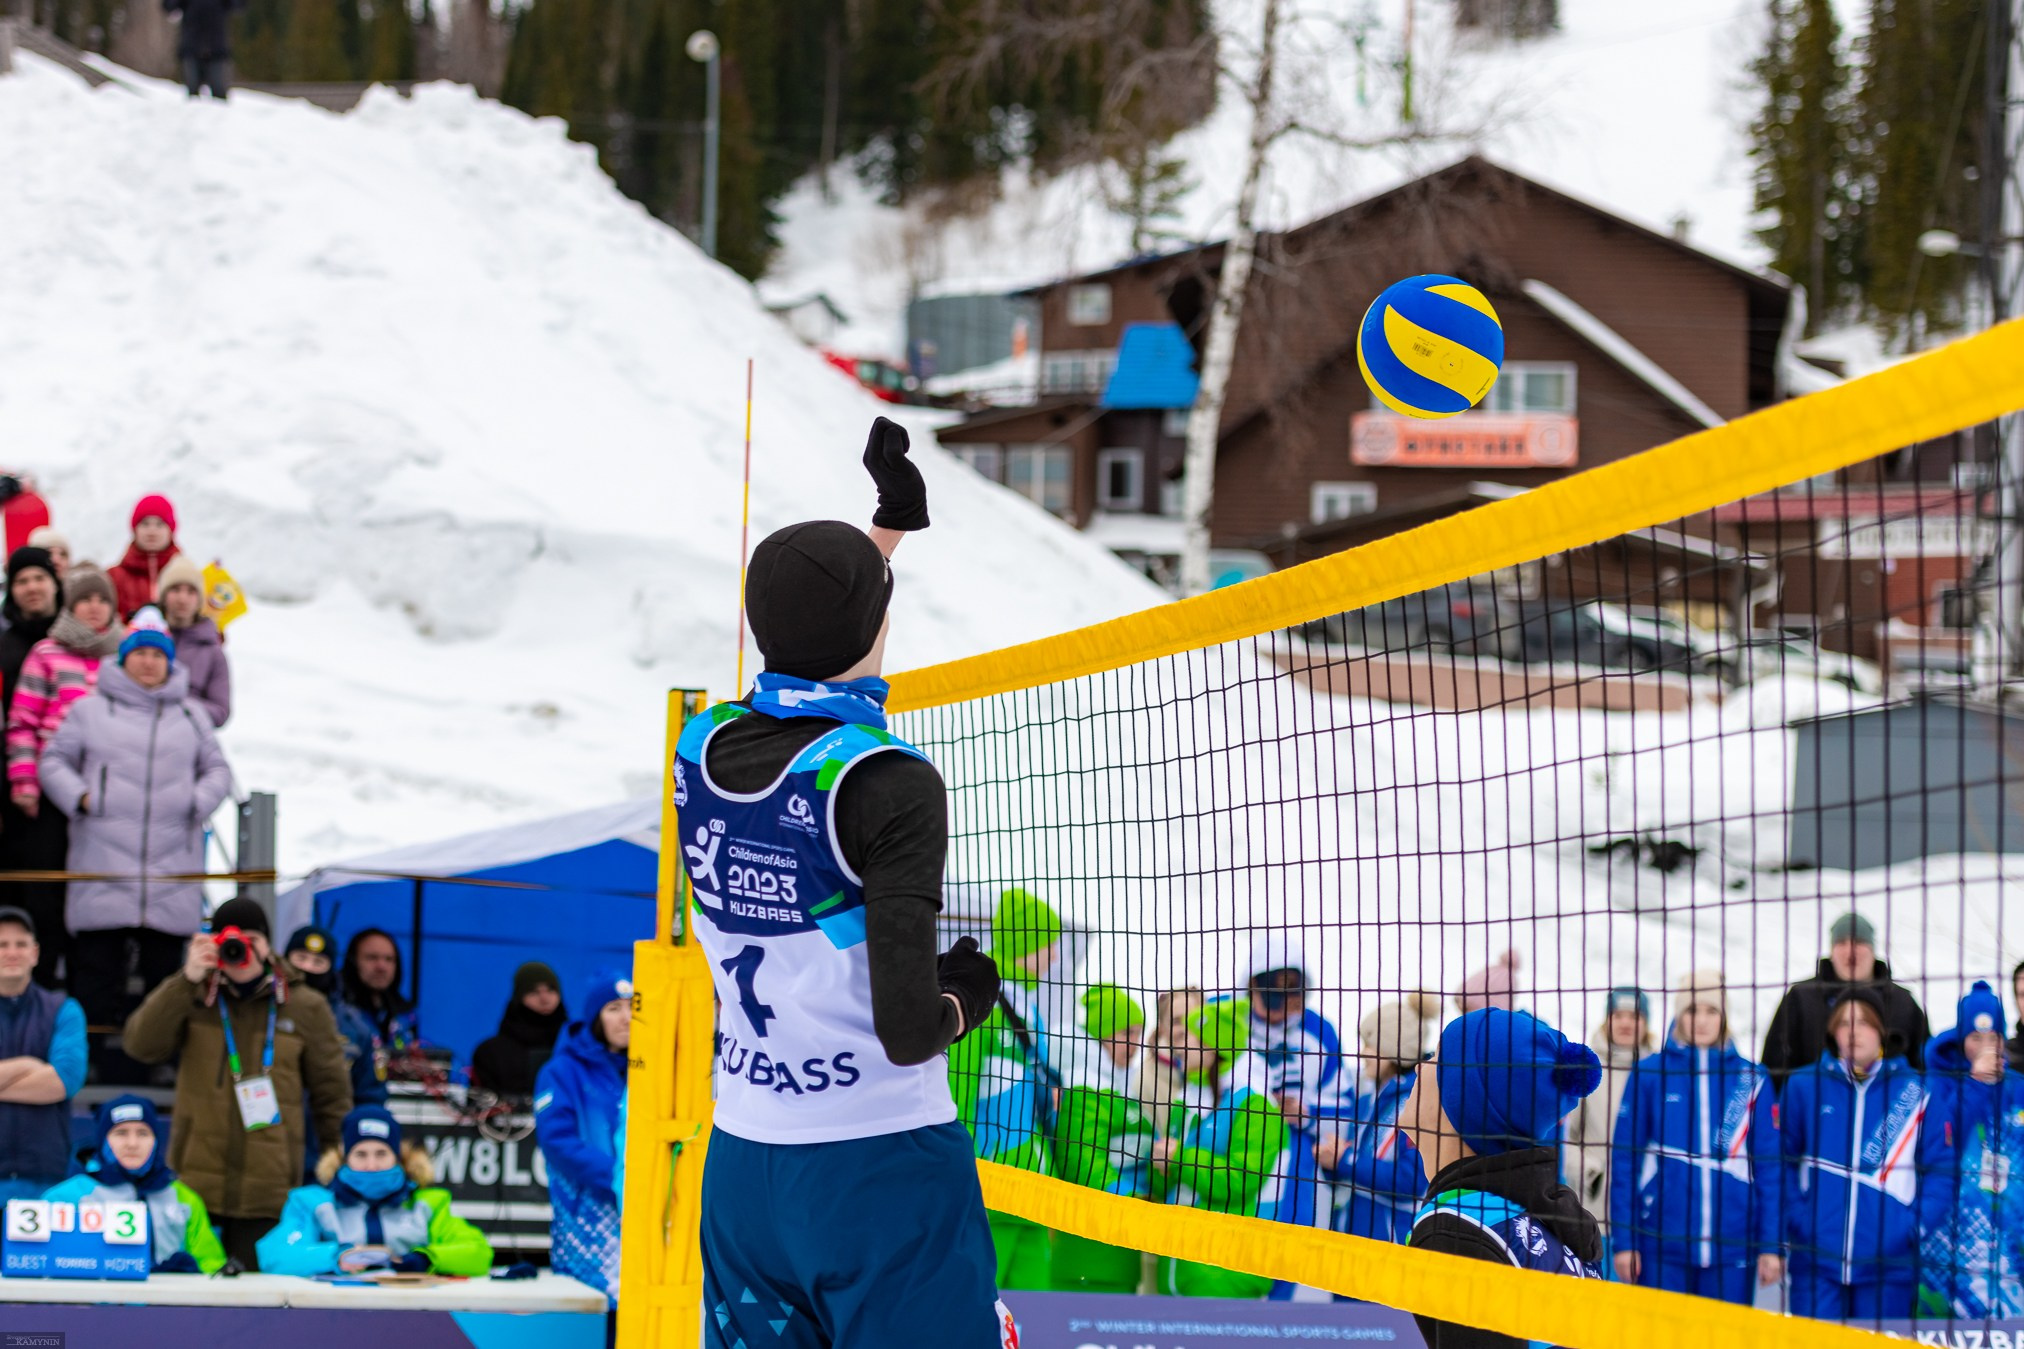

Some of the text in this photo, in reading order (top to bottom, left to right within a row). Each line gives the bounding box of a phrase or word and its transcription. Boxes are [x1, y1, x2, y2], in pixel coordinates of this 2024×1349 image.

[728, 865, 798, 904] 2023
[729, 900, 804, 923] KUZBASS
[717, 1031, 860, 1095] KUBASS
[17, 1207, 40, 1234] 3
[83, 1209, 103, 1232] 0
[114, 1210, 137, 1238] 3
[6, 1254, 48, 1270] GUEST
[103, 1257, 146, 1273] HOME
[1094, 1319, 1154, 1335] WINTER
[1158, 1320, 1280, 1338] INTERNATIONAL
[1281, 1323, 1340, 1340] SPORTS
[1341, 1326, 1397, 1342] GAMES
